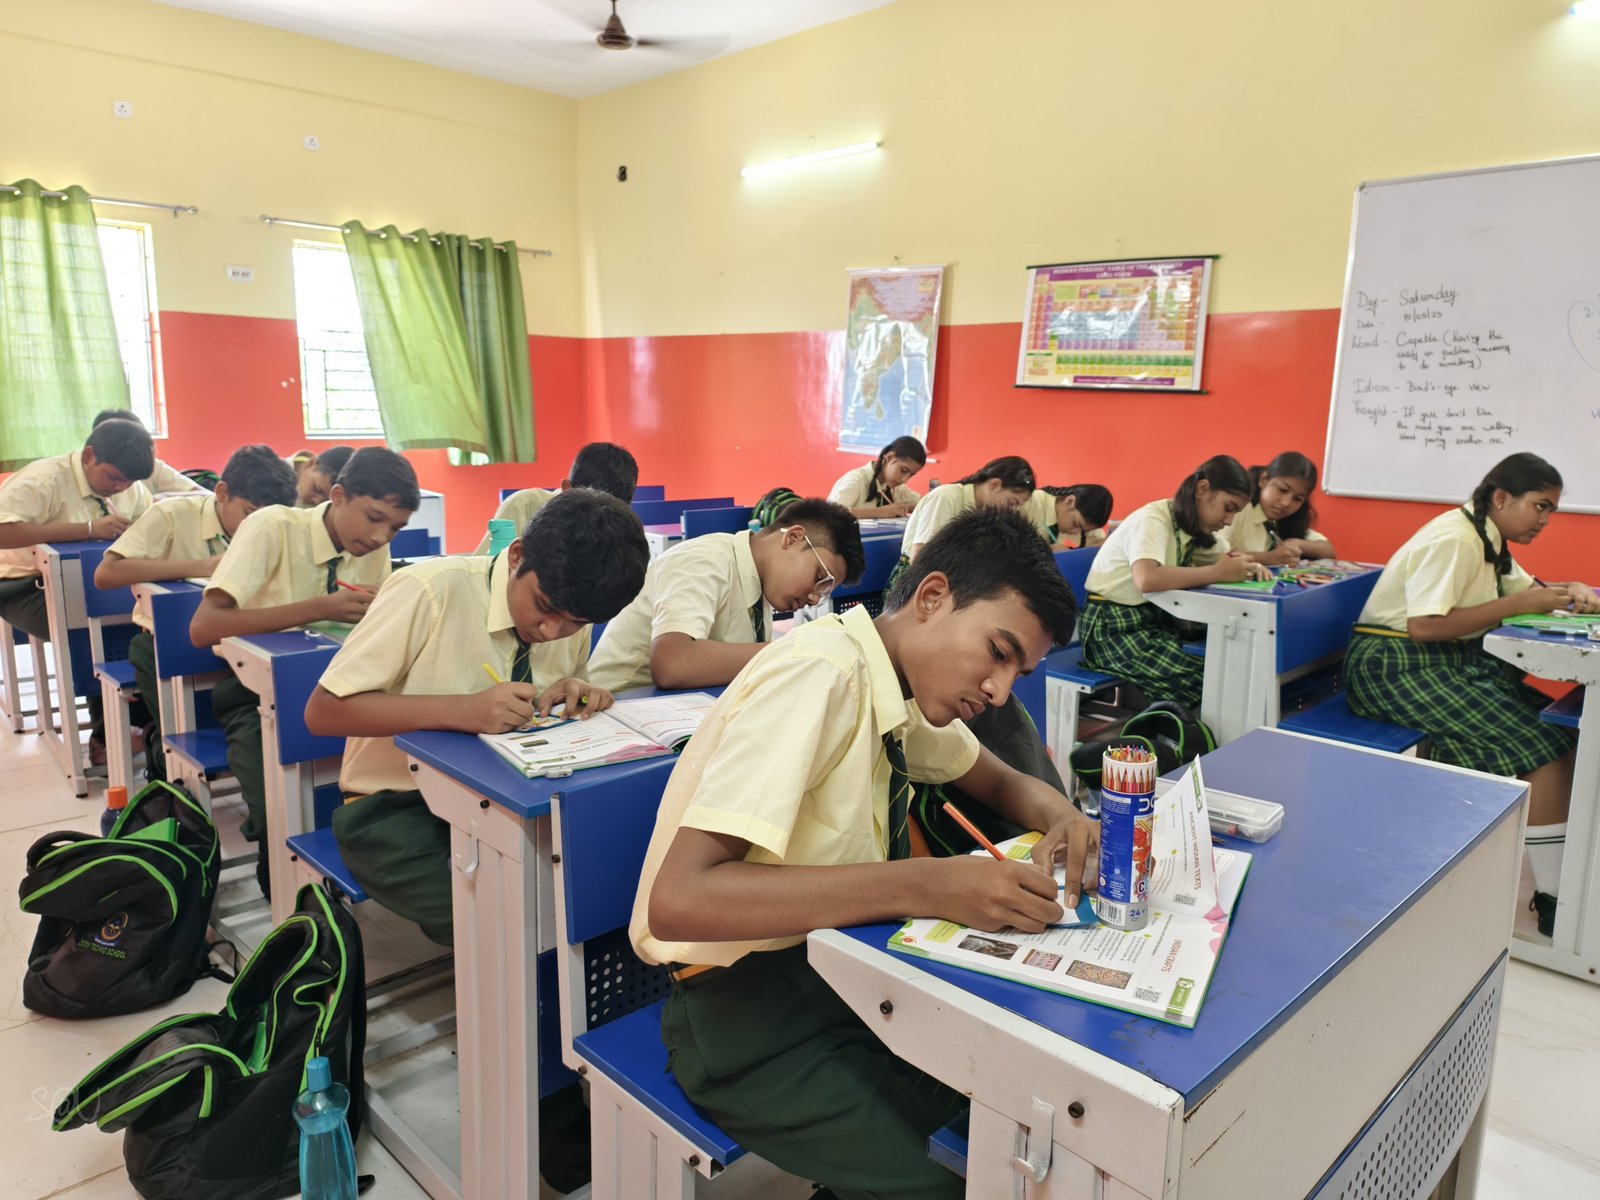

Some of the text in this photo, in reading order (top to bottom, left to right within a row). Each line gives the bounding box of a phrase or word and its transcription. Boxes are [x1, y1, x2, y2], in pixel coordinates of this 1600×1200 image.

[1400, 283, 1456, 307] Saturday
[1396, 331, 1439, 352] Capable
[1489, 330, 1504, 341] the
[1353, 379, 1391, 395] Idiom
[1469, 379, 1490, 392] view
[1352, 400, 1387, 425] Thought
[1402, 406, 1415, 418] If
[1194, 869, 1202, 891] TEXTS
